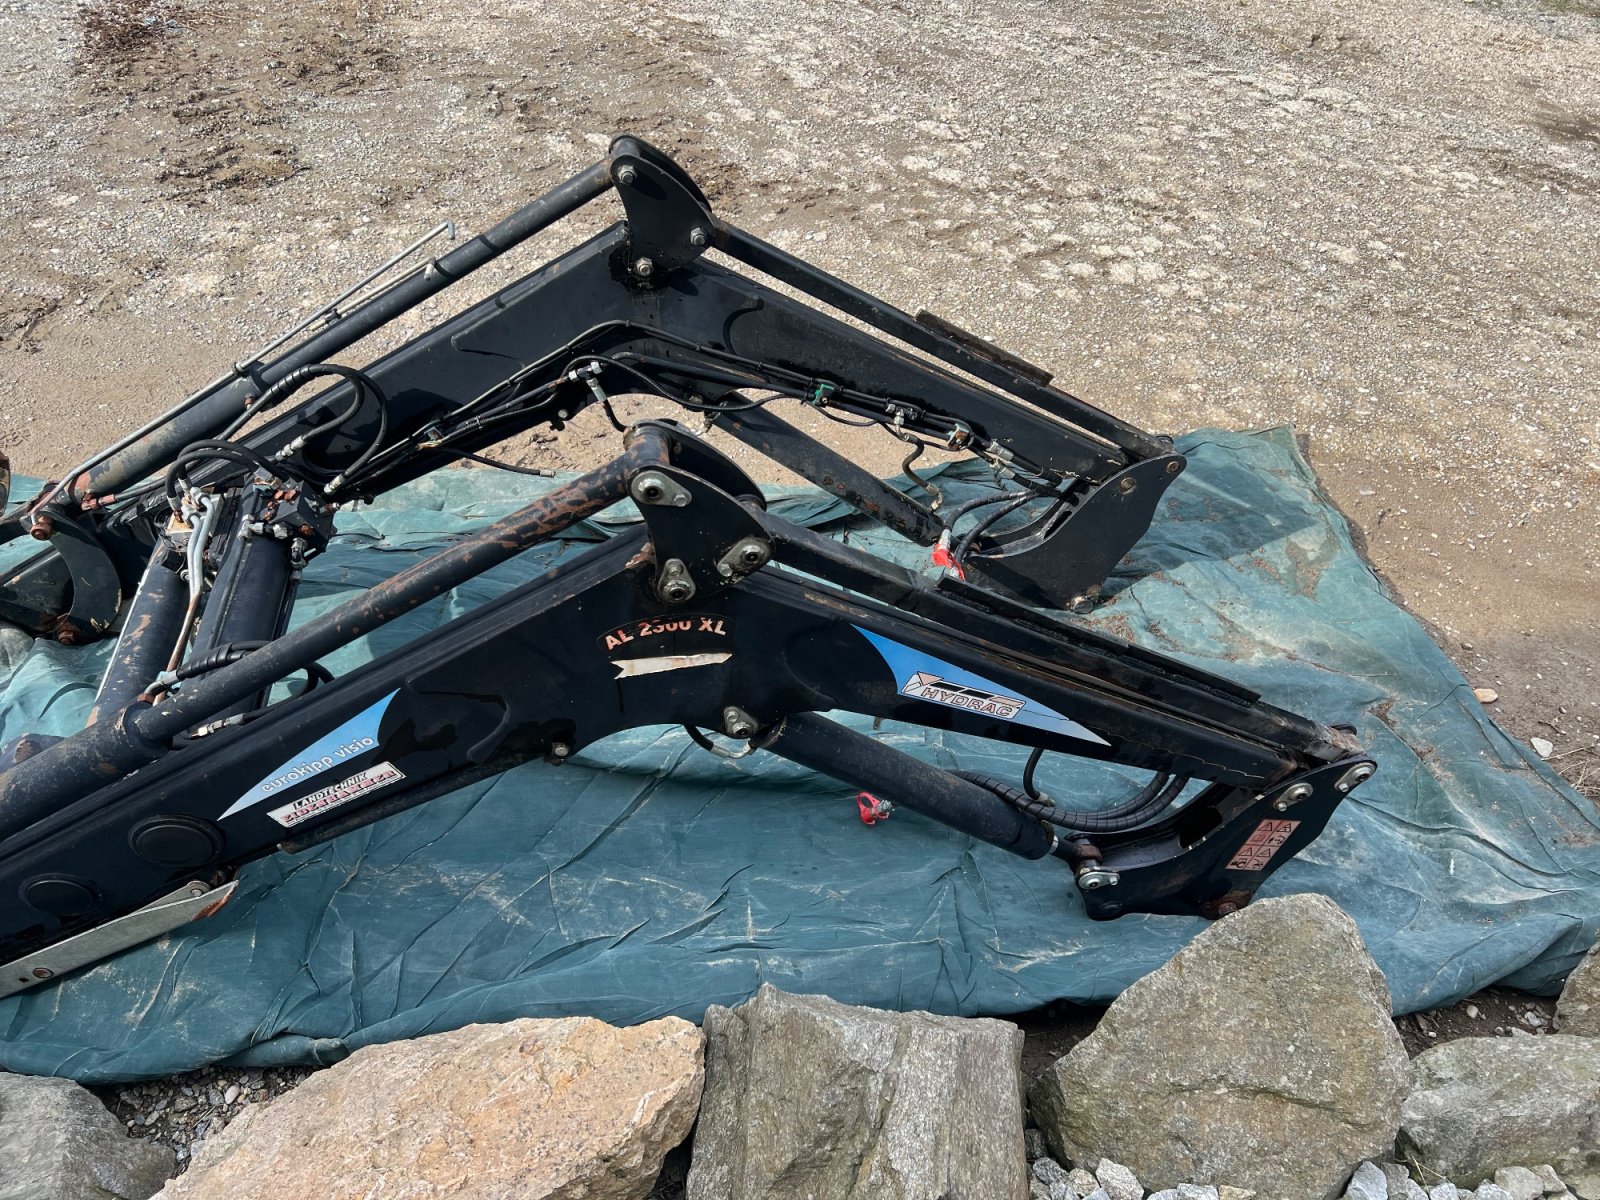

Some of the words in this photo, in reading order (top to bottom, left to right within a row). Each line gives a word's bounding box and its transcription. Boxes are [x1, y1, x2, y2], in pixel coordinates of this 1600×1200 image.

[605, 629, 634, 650] AL
[698, 617, 726, 636] XL
[920, 687, 1013, 717] HYDRAC
[261, 754, 334, 793] eurokipp
[334, 736, 374, 759] visio
[293, 772, 367, 810] LANDTECHNIK
